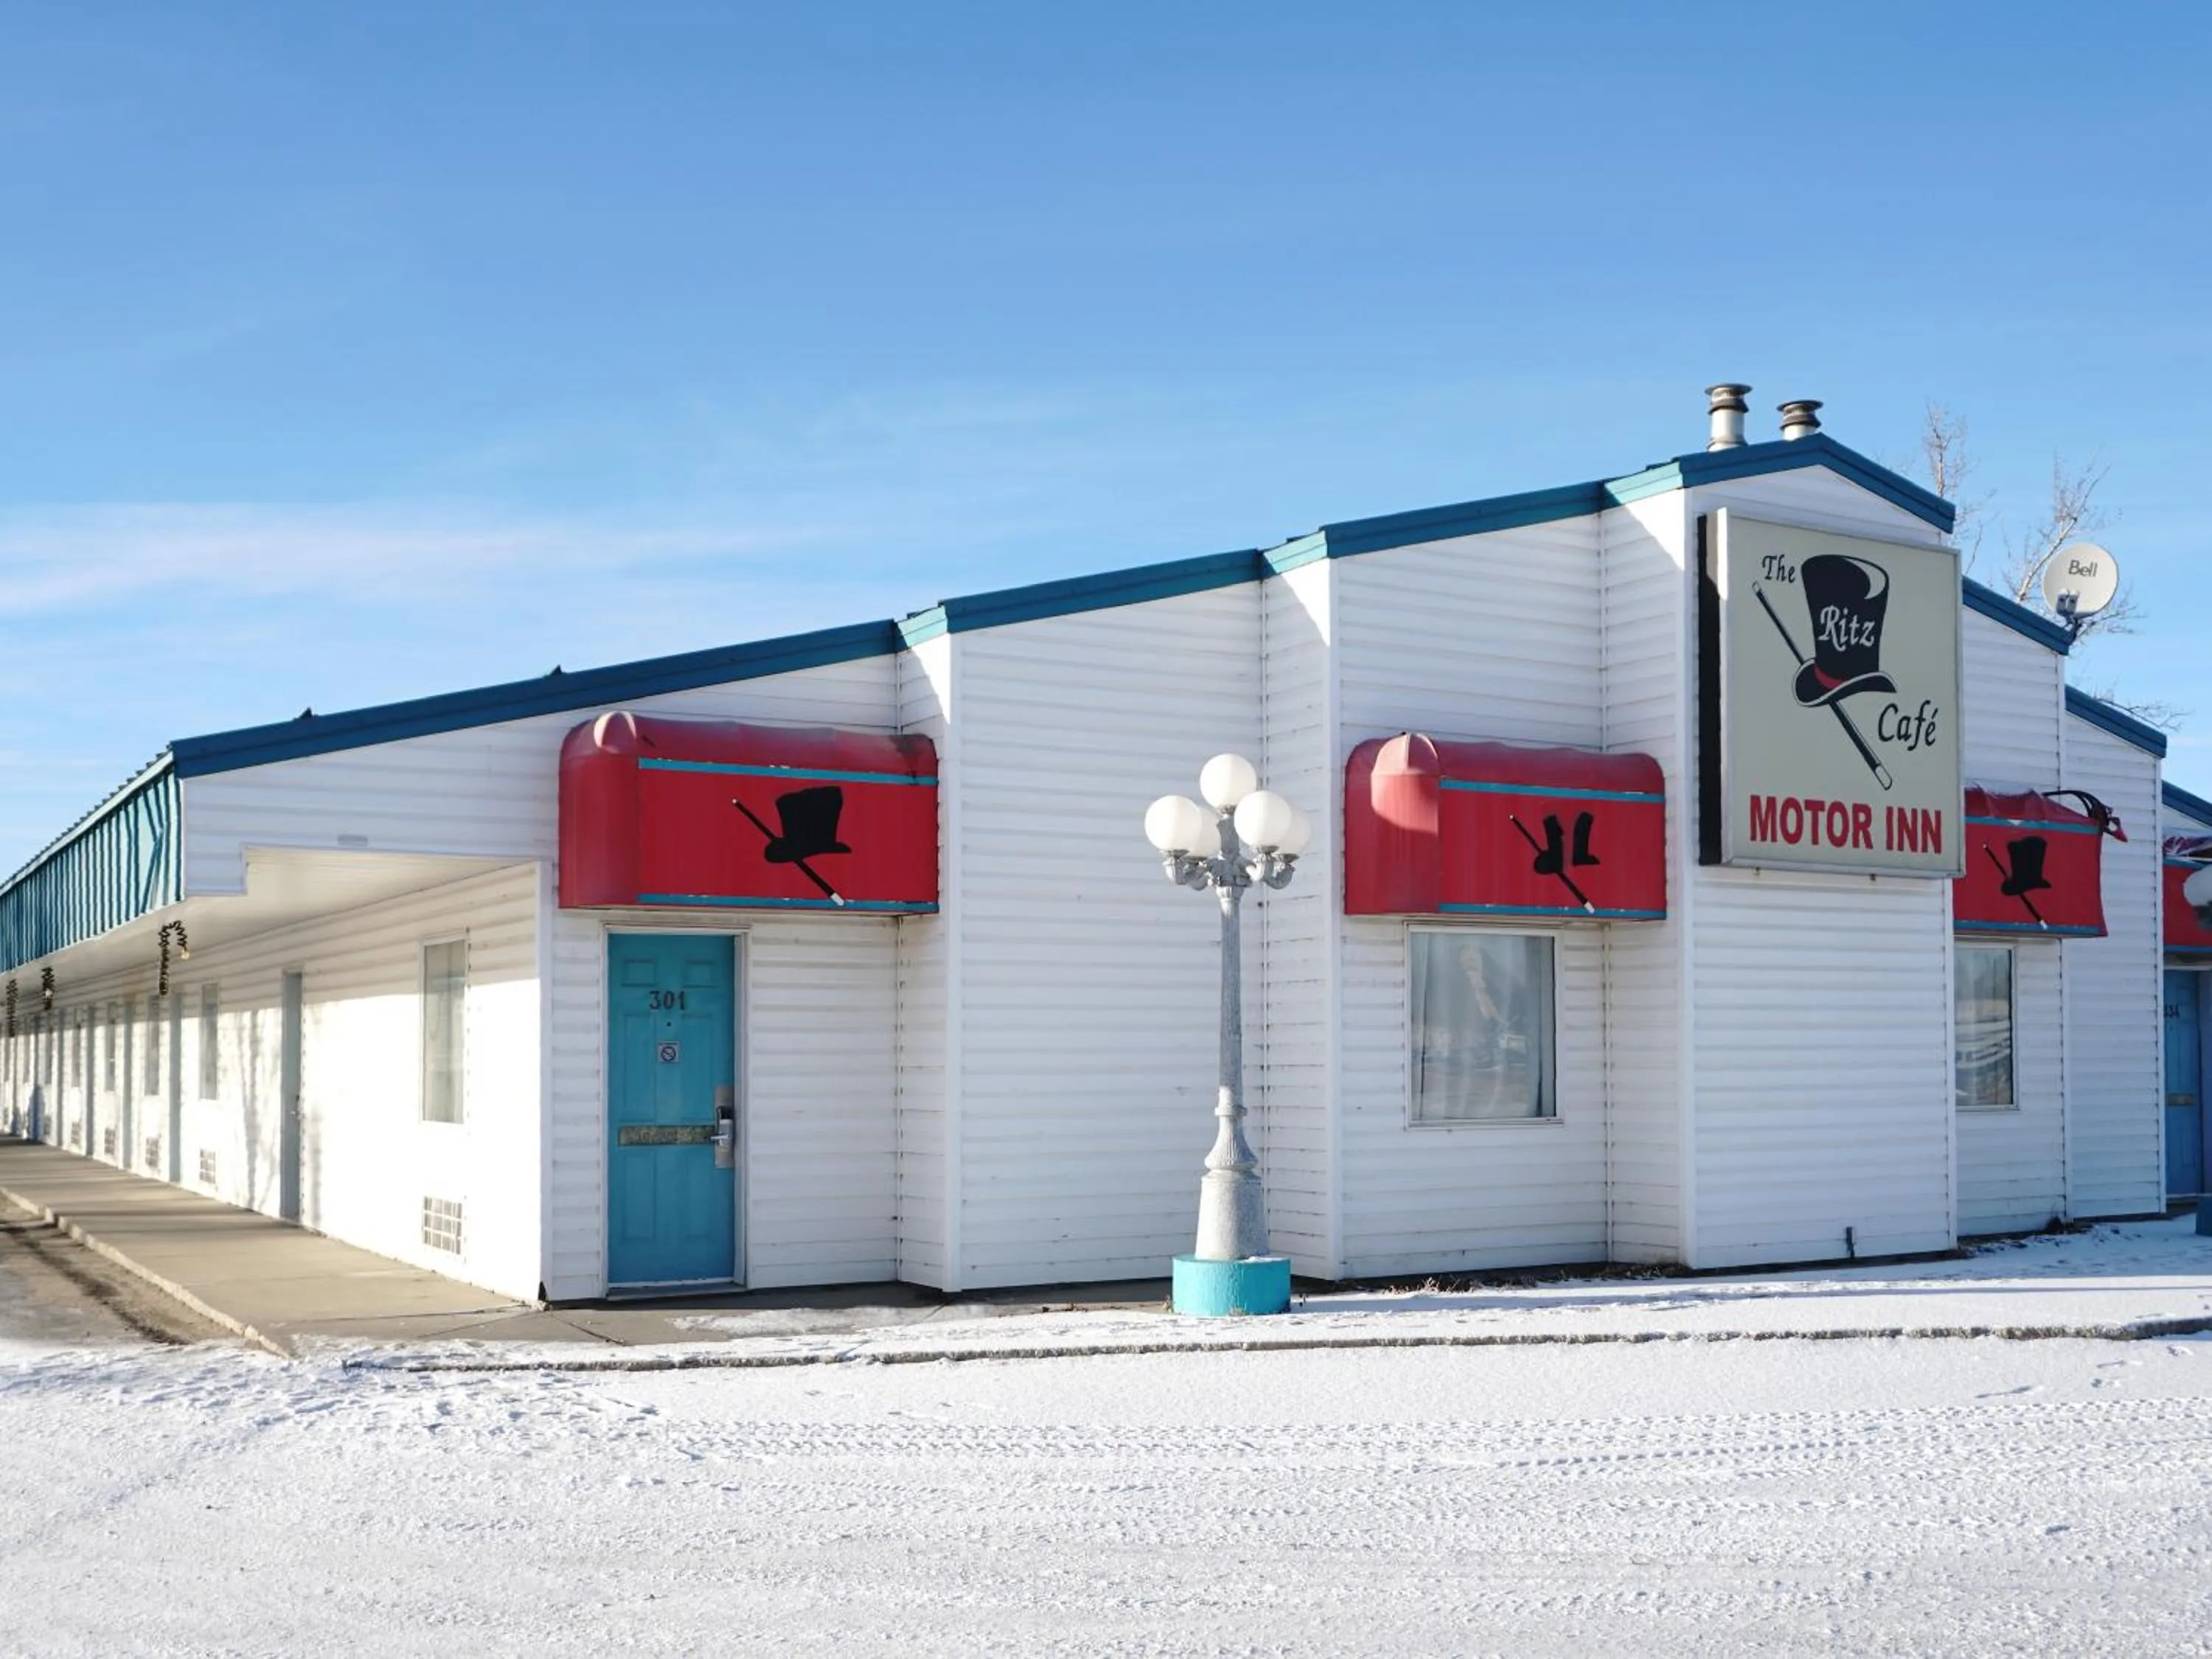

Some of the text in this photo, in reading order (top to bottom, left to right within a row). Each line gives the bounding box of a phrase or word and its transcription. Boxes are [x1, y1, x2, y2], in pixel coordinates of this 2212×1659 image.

[1761, 554, 1796, 583] The
[2068, 560, 2098, 577] Bell
[1818, 605, 1875, 652] Ritz
[1877, 700, 1938, 751] Café
[1750, 794, 1942, 855] MOTOR INN
[649, 990, 684, 1010] 301
